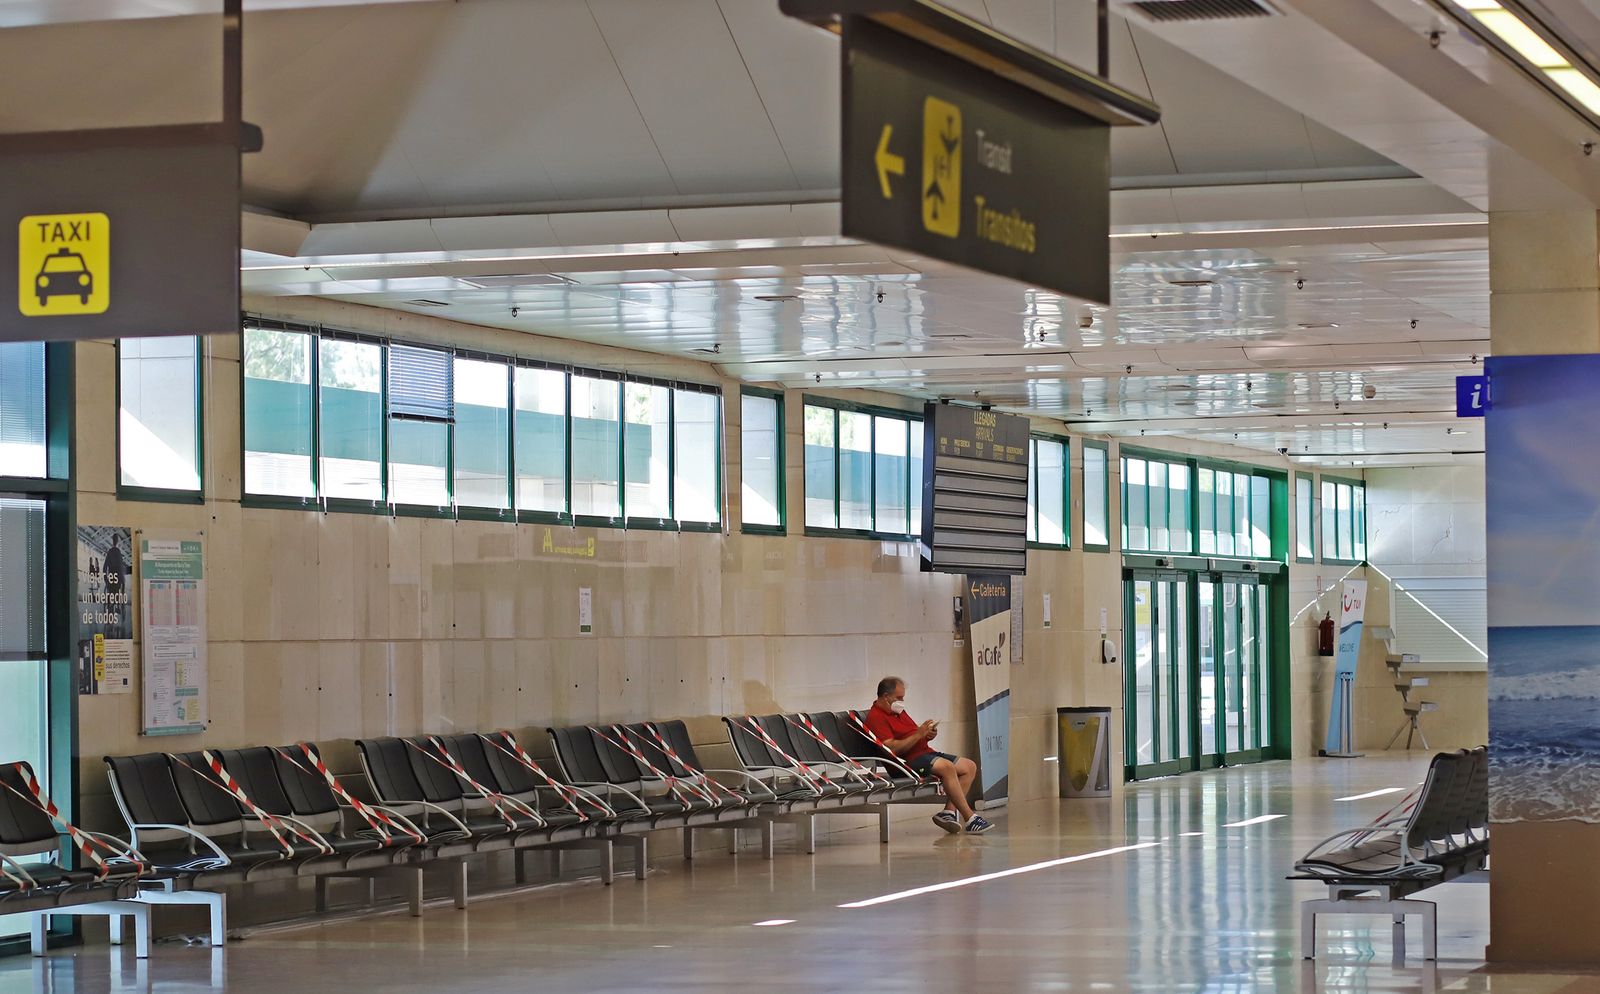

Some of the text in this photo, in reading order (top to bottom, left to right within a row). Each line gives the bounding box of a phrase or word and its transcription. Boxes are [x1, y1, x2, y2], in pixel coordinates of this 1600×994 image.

[975, 129, 1012, 174] Transit
[37, 221, 90, 243] TAXI
[974, 410, 997, 427] LLEGADAS
[108, 572, 119, 584] es
[82, 588, 128, 604] un derecho
[980, 582, 1006, 597] Cafetería
[82, 609, 119, 625] de todos
